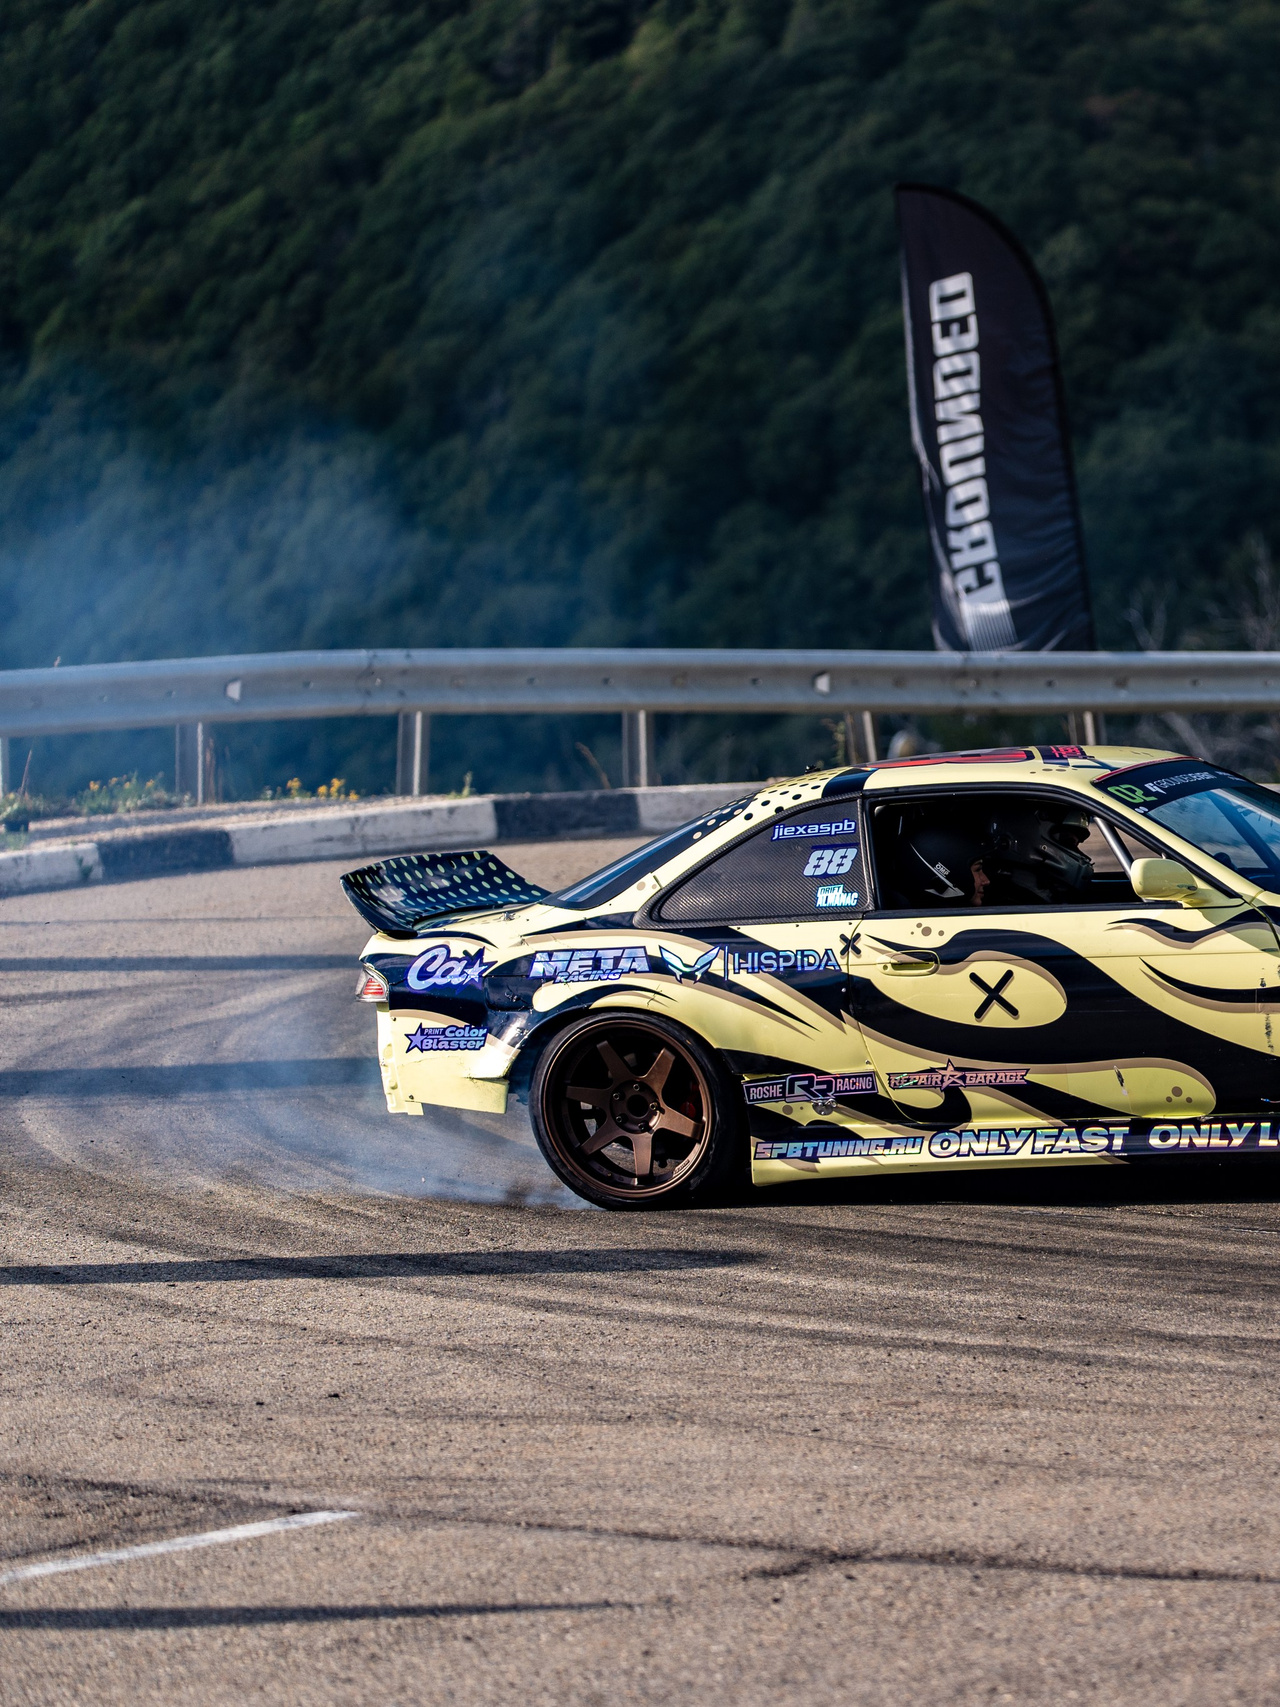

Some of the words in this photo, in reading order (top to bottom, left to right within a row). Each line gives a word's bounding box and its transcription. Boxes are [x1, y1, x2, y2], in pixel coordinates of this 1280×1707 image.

[772, 819, 856, 840] jiexaspb
[803, 848, 858, 876] 88
[935, 863, 949, 876] OMP
[820, 886, 841, 895] DRIFT
[816, 892, 858, 907] ALMANAC
[530, 947, 650, 978] META
[733, 949, 840, 974] HISPIDA
[554, 969, 623, 983] RACING
[445, 1026, 487, 1037] Color
[422, 1039, 484, 1050] Blaster
[965, 1071, 1027, 1085] GARAGE
[750, 1084, 783, 1100] ROSHE
[836, 1077, 873, 1091] RACING
[755, 1137, 923, 1159] SPBTUNING.RU
[930, 1128, 1029, 1158] ONLY
[1033, 1126, 1130, 1153] FAST
[1149, 1121, 1256, 1149] ONLY
